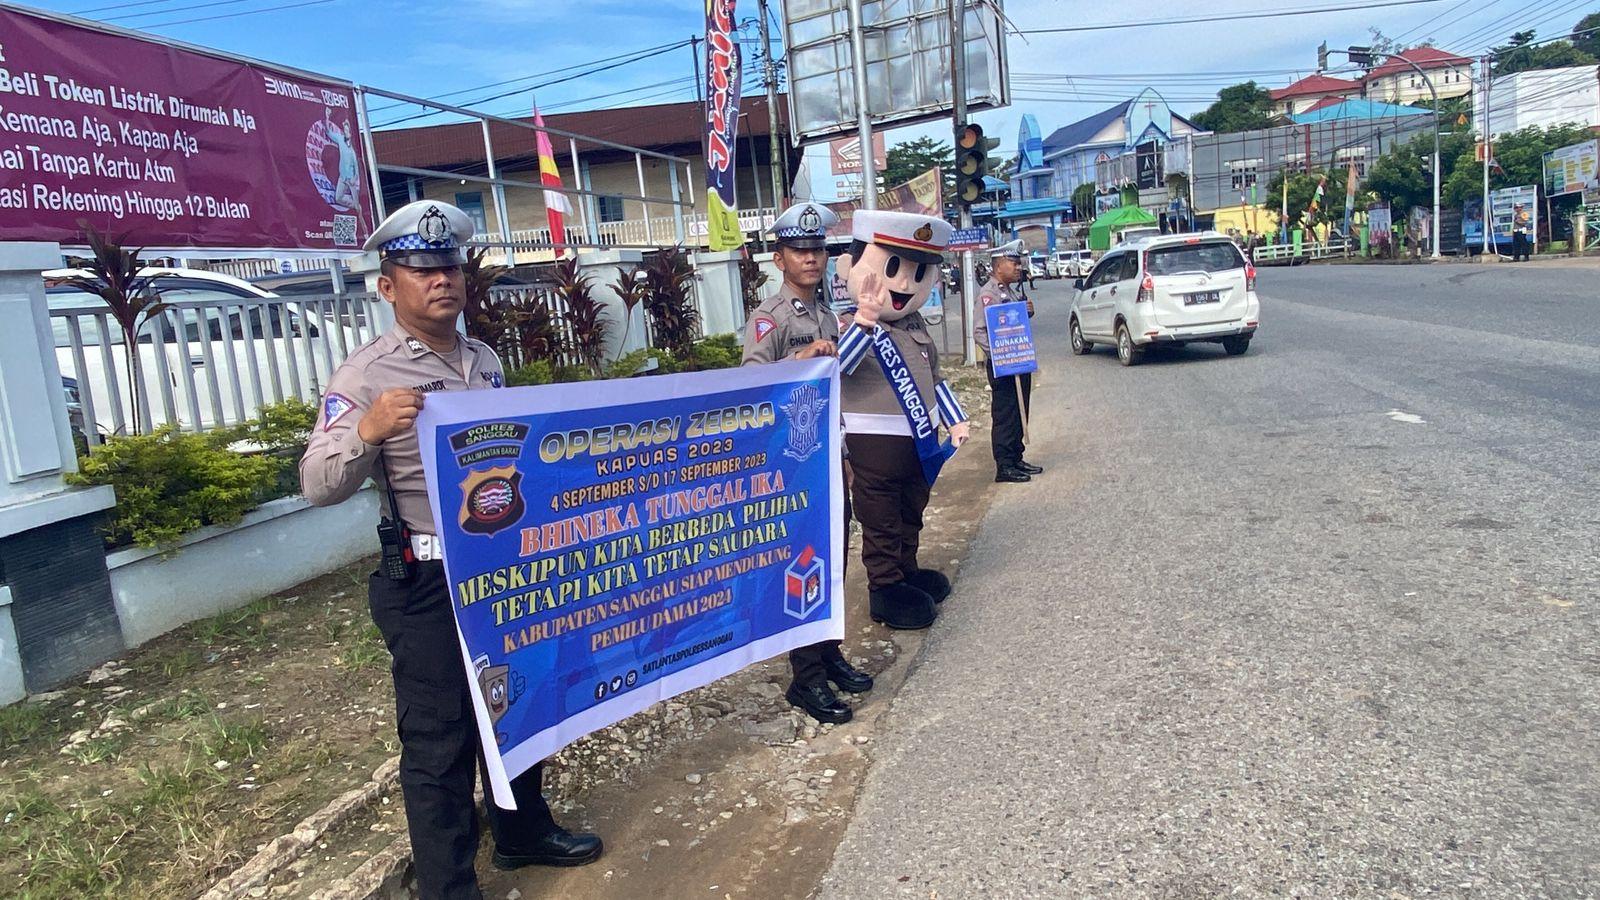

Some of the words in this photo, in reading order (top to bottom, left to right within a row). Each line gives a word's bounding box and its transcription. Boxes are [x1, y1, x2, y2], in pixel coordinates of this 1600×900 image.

[0, 68, 40, 96] Beli
[43, 75, 106, 106] Token
[110, 86, 166, 116] Listrik
[169, 96, 229, 126] Dirumah
[233, 109, 256, 133] Aja
[26, 146, 90, 180] Tanpa
[93, 152, 140, 180] Kartu
[144, 159, 176, 183] Atm
[82, 115, 117, 147] Aja,
[119, 120, 170, 153] Kapan
[174, 129, 199, 158] Aja
[33, 184, 124, 218] Rekening
[125, 190, 184, 220] Hingga
[185, 195, 204, 217] 12
[205, 196, 250, 218] Bulan
[412, 380, 446, 393] UMARDI
[891, 367, 931, 439] SANGGAU
[461, 447, 500, 464] KALIMANTAN
[500, 446, 519, 456] BARAT
[465, 431, 518, 446] SANGGAU
[468, 423, 515, 438] POLRES
[539, 416, 681, 463] OPERASI
[686, 401, 775, 438] ZEBRA
[596, 447, 678, 476] KAPUAS
[688, 438, 733, 458] 2023
[551, 495, 559, 511] 4
[562, 478, 635, 509] SEPTEMBER
[639, 473, 659, 492] S/D
[663, 470, 676, 486] 17
[681, 457, 741, 482] SEPTEMBER
[744, 452, 766, 469] 2023
[519, 502, 640, 557] BHINEKA
[645, 478, 747, 524] TUNGGAL
[750, 469, 785, 498] IKA
[458, 548, 588, 608] MESKIPUN
[593, 534, 643, 567] KITA
[648, 510, 736, 550] BERBEDA
[743, 490, 809, 524] PILIHAN
[491, 578, 581, 626] TETAPI
[587, 562, 638, 597] KITA
[643, 542, 704, 579] TETAP
[708, 520, 787, 559] SAUDARA
[504, 602, 608, 653] KABUPATEN
[609, 579, 680, 617] SANGGAU
[681, 568, 713, 594] SIAP
[714, 545, 791, 580] MENDUKUNG
[591, 614, 651, 652] PEMILU
[652, 599, 699, 629] DAMAI
[700, 588, 732, 612] 2024
